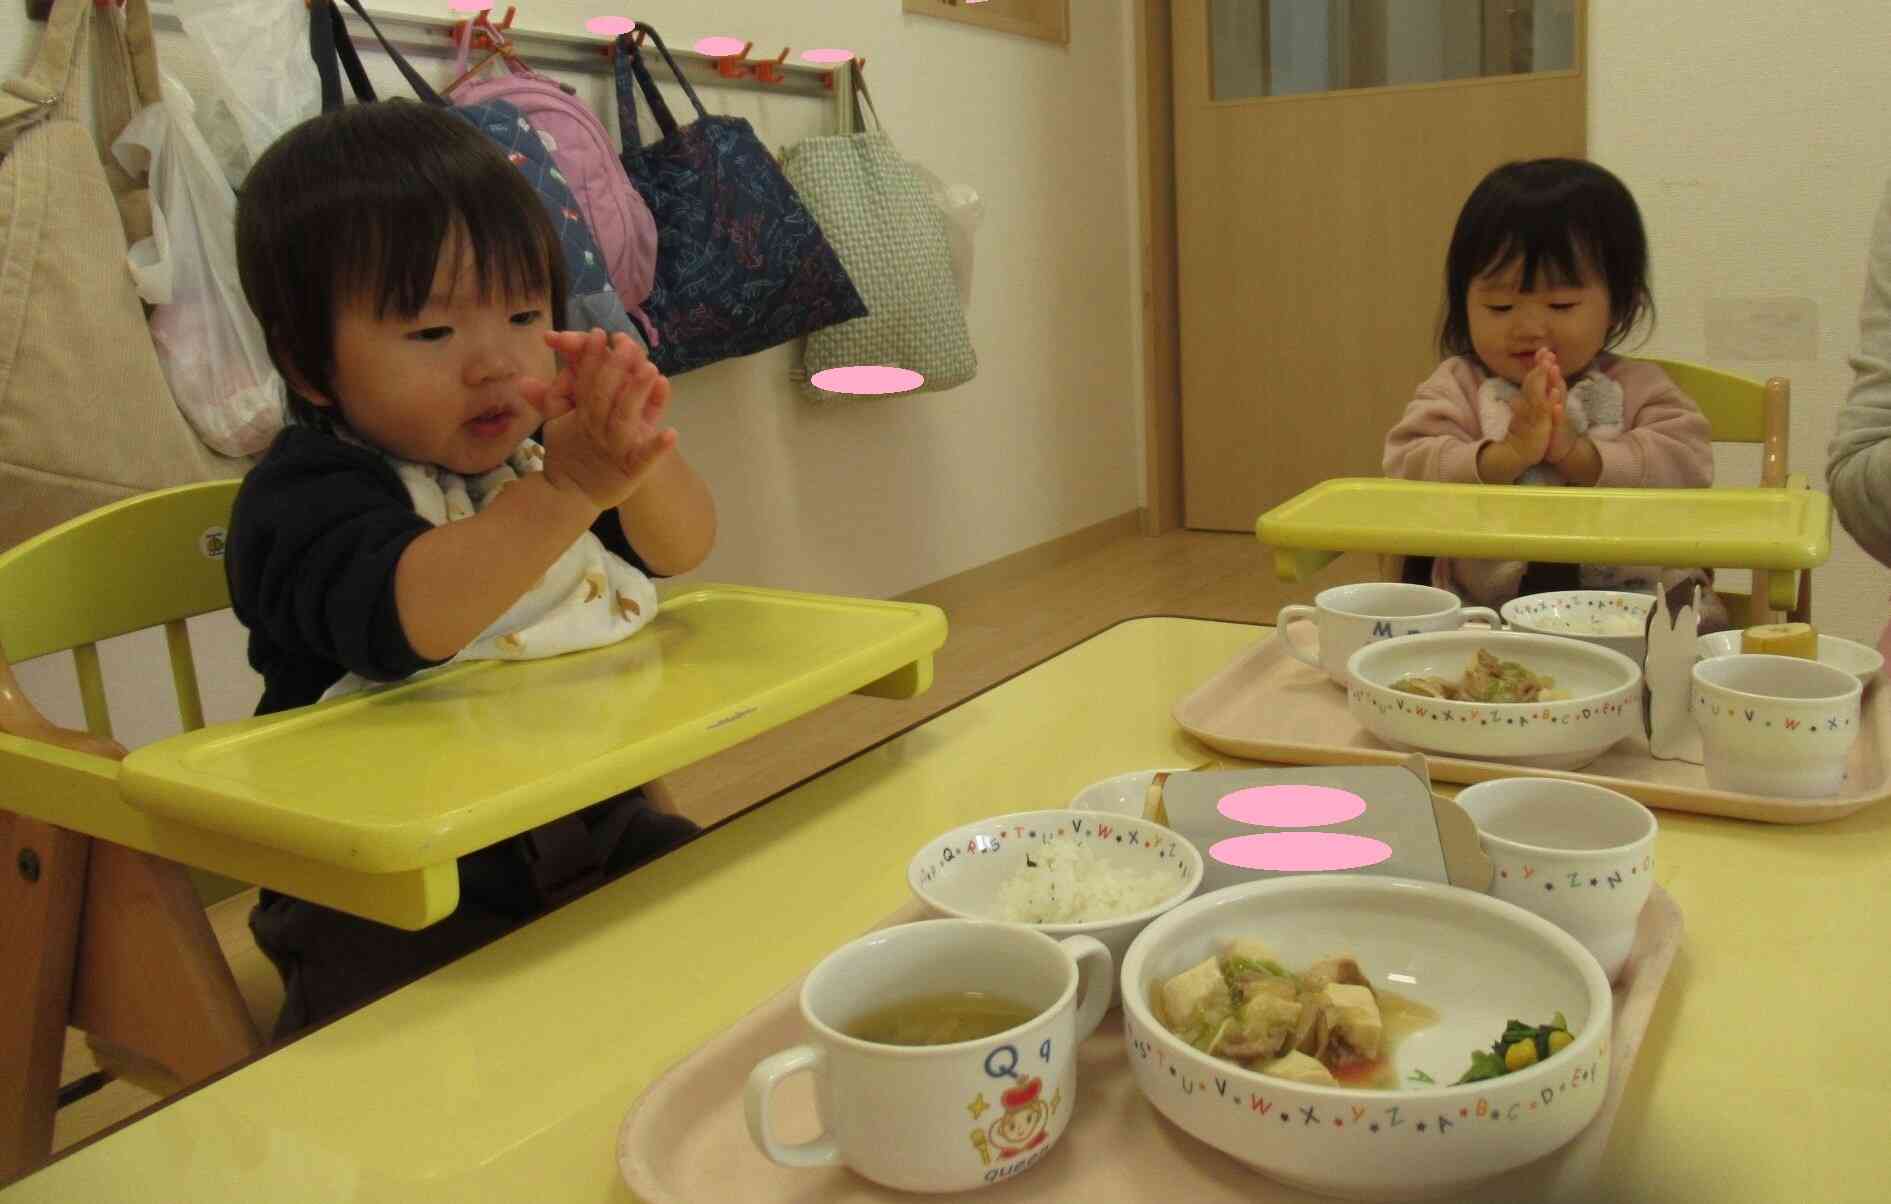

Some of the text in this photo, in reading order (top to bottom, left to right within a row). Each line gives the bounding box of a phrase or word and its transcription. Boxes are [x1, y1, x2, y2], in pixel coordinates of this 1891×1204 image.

[1372, 621, 1393, 638] M
[1582, 708, 1592, 719] D
[1745, 709, 1754, 721] V
[1784, 716, 1801, 730] W
[1828, 717, 1838, 730] X
[943, 847, 956, 862] Q
[967, 840, 977, 856] R
[1014, 826, 1025, 839] T
[1072, 818, 1083, 833] V
[1098, 823, 1113, 840] W
[1128, 830, 1139, 845] X
[1567, 872, 1582, 889] Z
[1607, 872, 1623, 889] N
[984, 1044, 1019, 1079] Q
[1182, 1075, 1194, 1095] U
[1215, 1077, 1227, 1096] V
[1250, 1094, 1273, 1116] W
[1300, 1105, 1321, 1126] X
[1351, 1104, 1366, 1122] Y
[1385, 1106, 1403, 1127] Z
[1437, 1115, 1455, 1135] A
[1475, 1097, 1488, 1119] B
[1507, 1104, 1520, 1121] C
[1541, 1088, 1554, 1105] D
